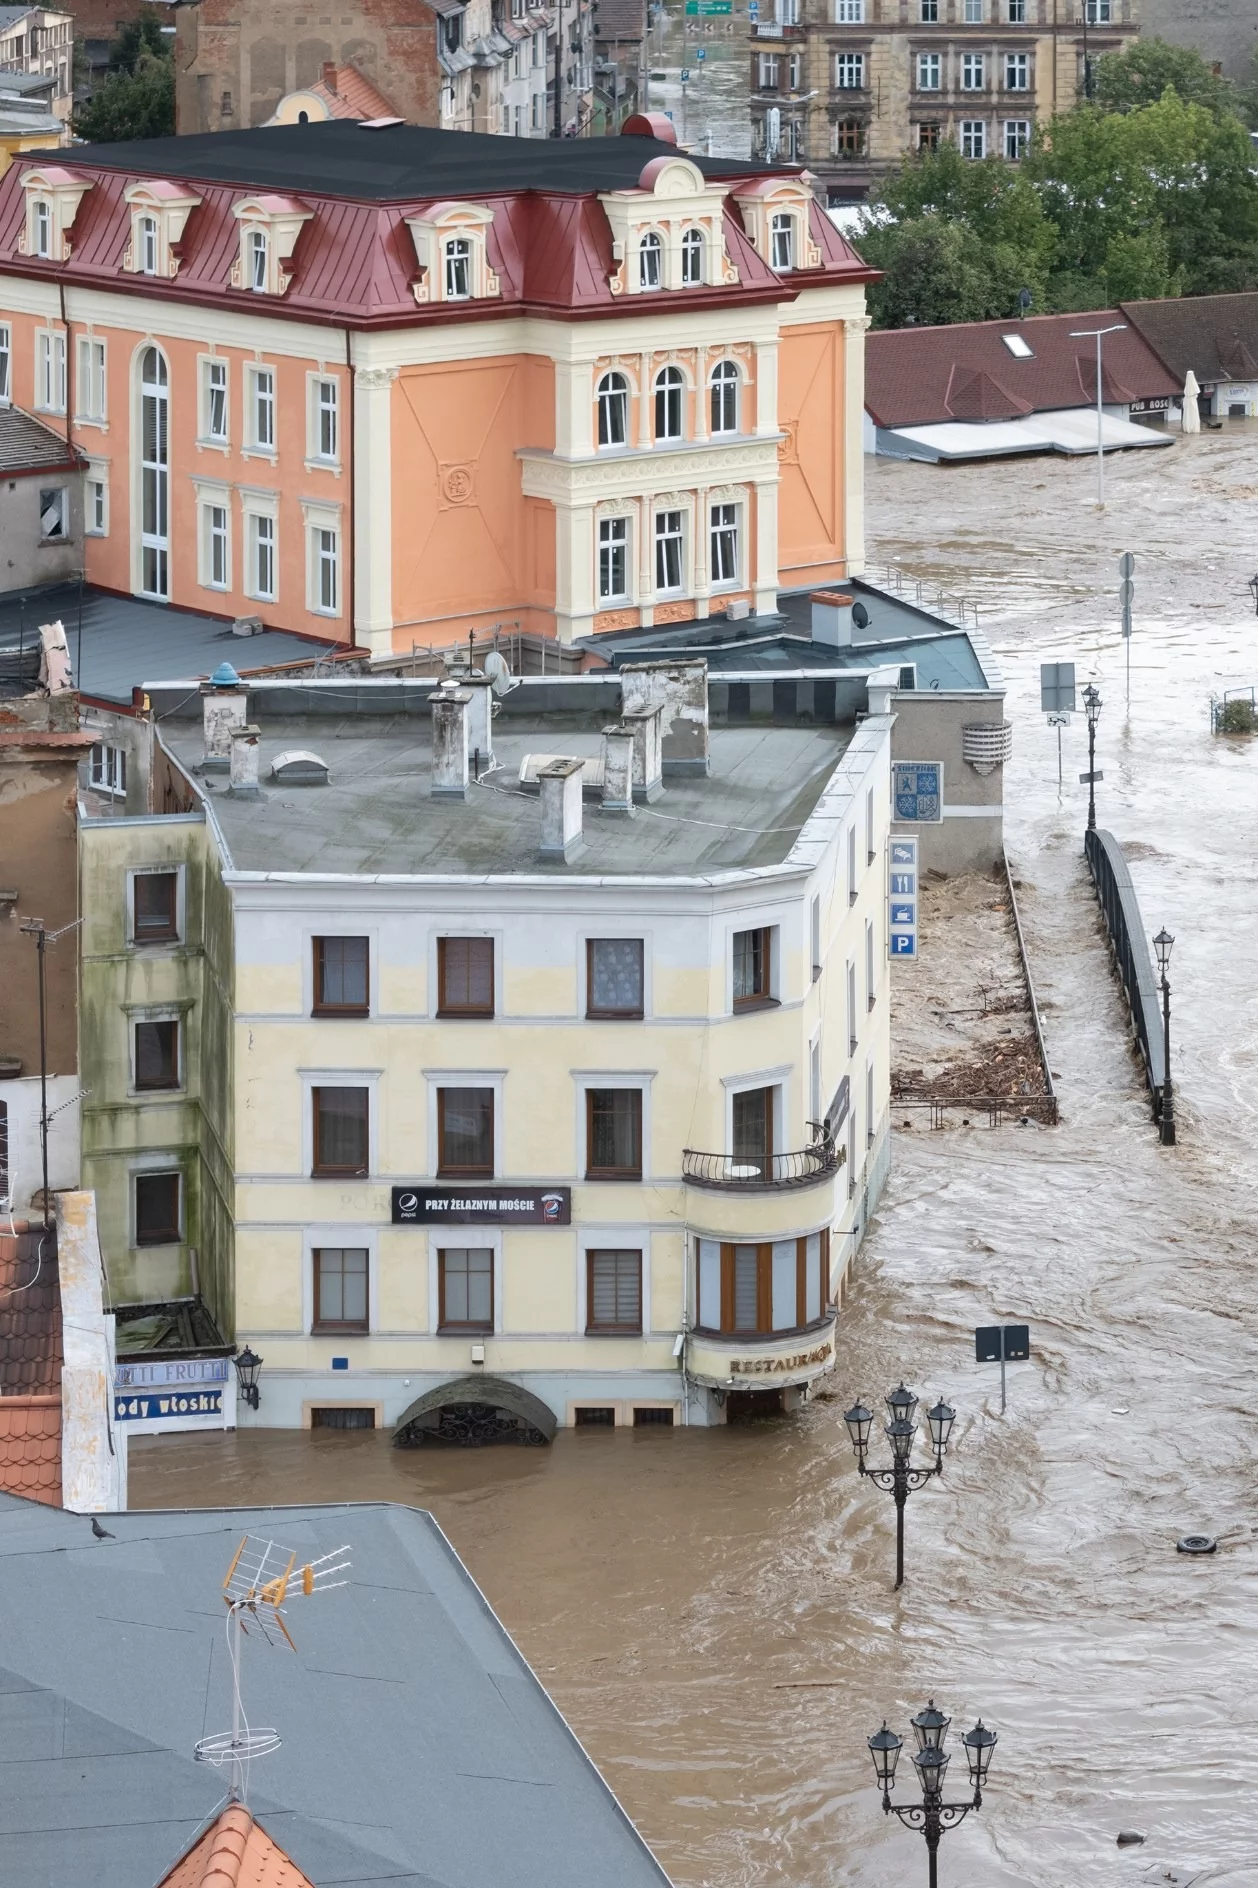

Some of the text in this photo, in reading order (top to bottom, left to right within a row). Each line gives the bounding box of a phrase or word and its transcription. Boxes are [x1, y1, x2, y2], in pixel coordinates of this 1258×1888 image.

[1132, 402, 1144, 410] PUB
[898, 937, 909, 952] P
[426, 1198, 534, 1210] PRZY ŻELAZNYM MOŚCIE
[165, 1360, 227, 1380] FRUTTI
[118, 1399, 149, 1417] ody
